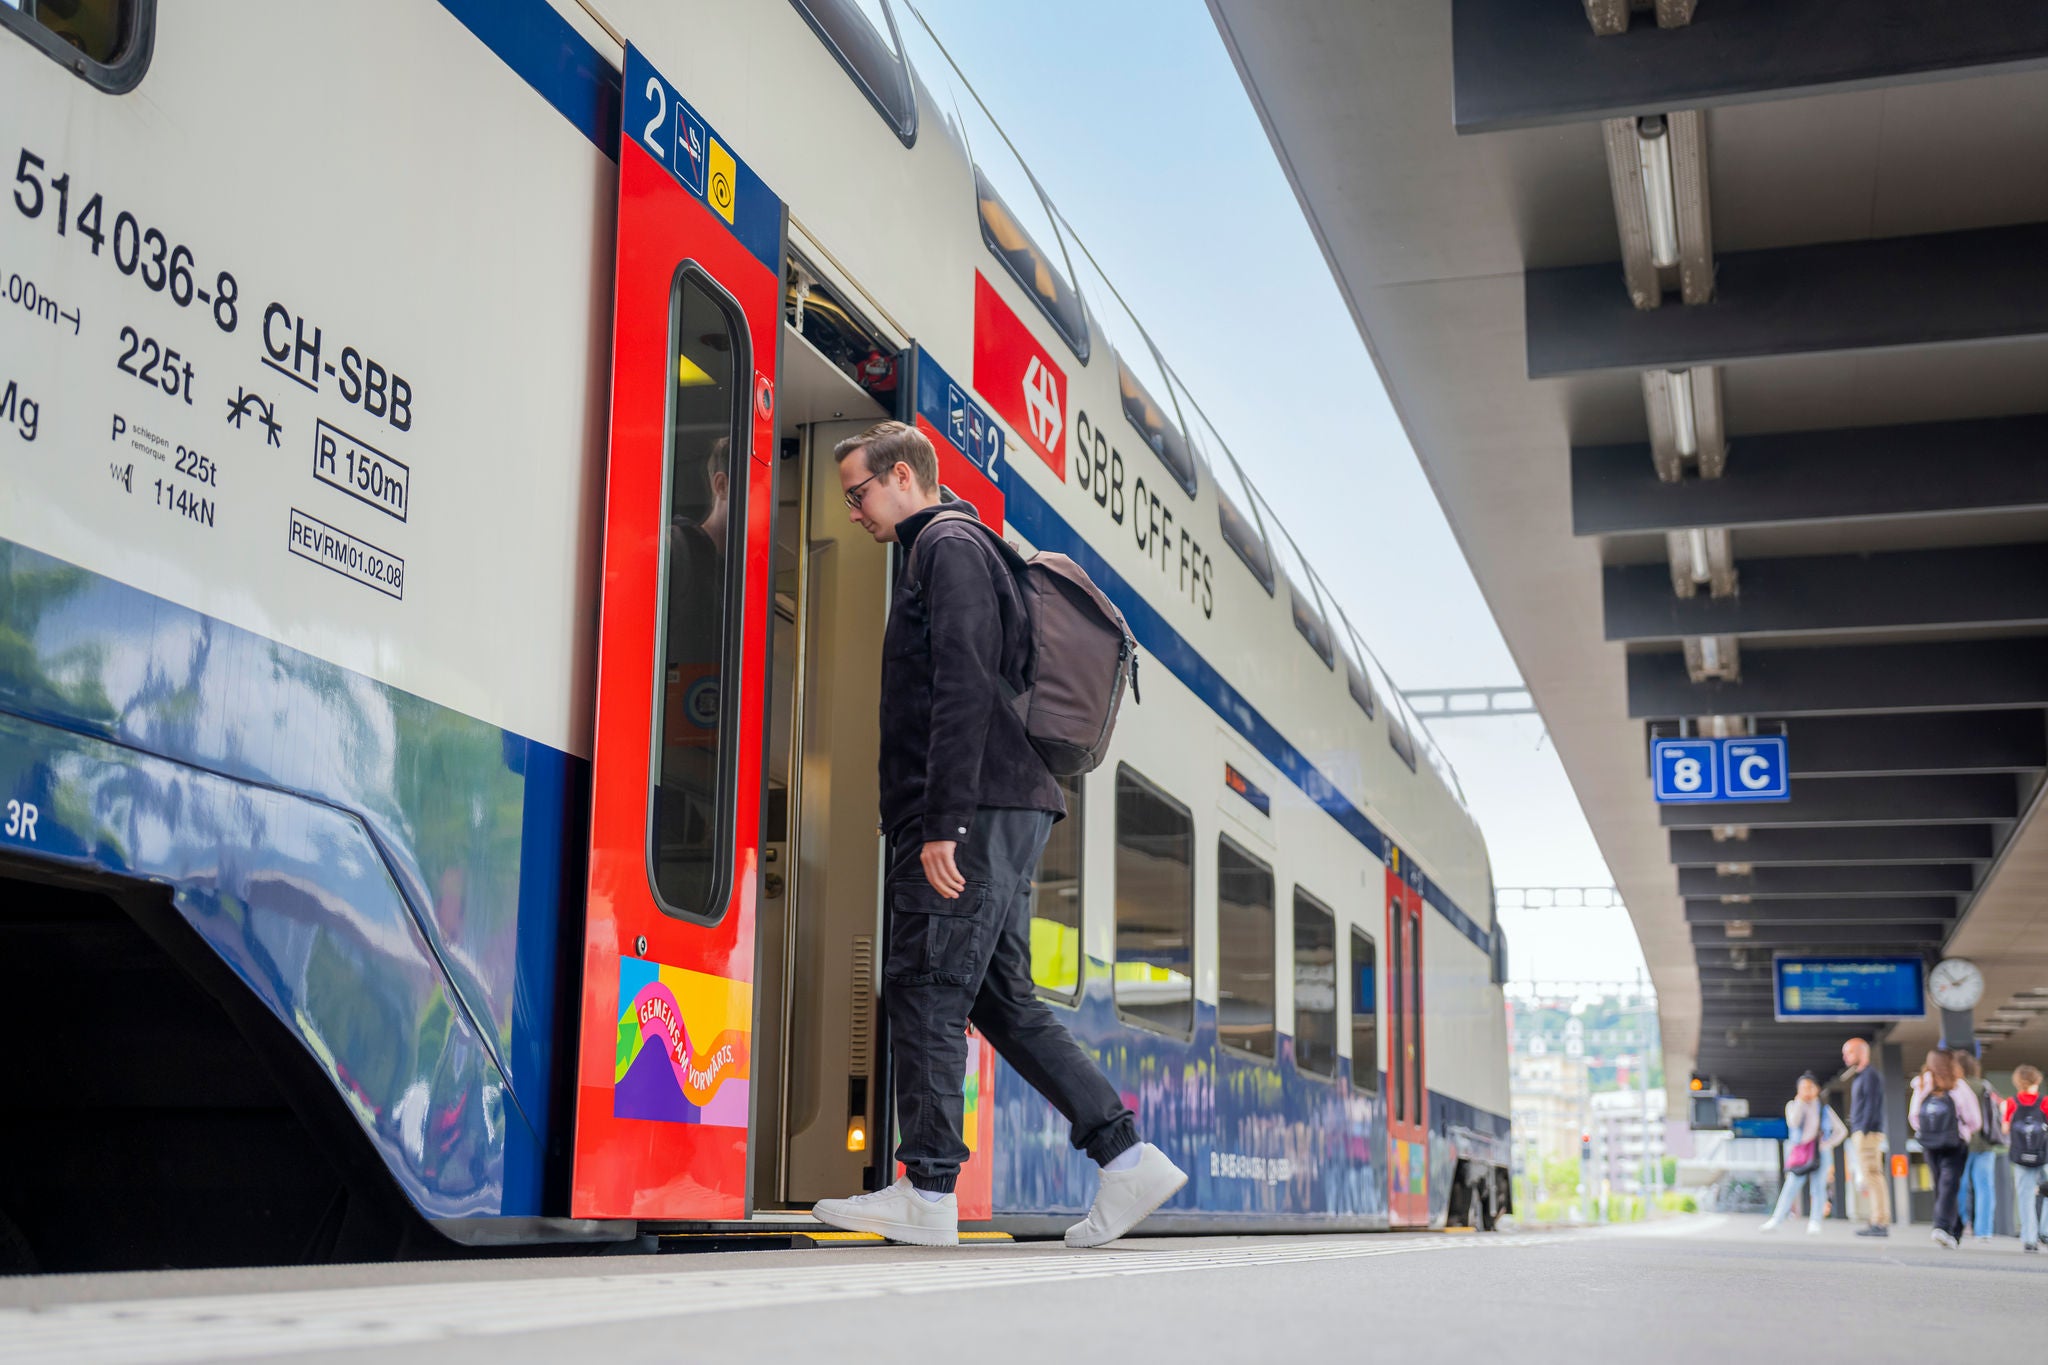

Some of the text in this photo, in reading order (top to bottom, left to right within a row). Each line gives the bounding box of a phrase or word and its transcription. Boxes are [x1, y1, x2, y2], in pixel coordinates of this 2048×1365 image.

[644, 76, 667, 160] 2
[0, 267, 58, 325] .00m
[117, 325, 195, 406] 225t
[261, 301, 412, 433] CH-SBB
[111, 413, 127, 441] P
[131, 440, 166, 462] remorque
[132, 424, 170, 448] schleppen
[174, 444, 217, 488] 225t
[319, 433, 404, 509] R 150m
[986, 425, 1000, 484] 2
[154, 478, 215, 528] 114kN
[1075, 409, 1214, 621] SBB CFF FFS
[348, 546, 403, 590] 01.02.08
[1673, 757, 1703, 792] 8
[1739, 755, 1770, 790] C
[4, 798, 39, 841] 3R
[640, 998, 735, 1091] GEMEINSAM VORWÄRTS.
